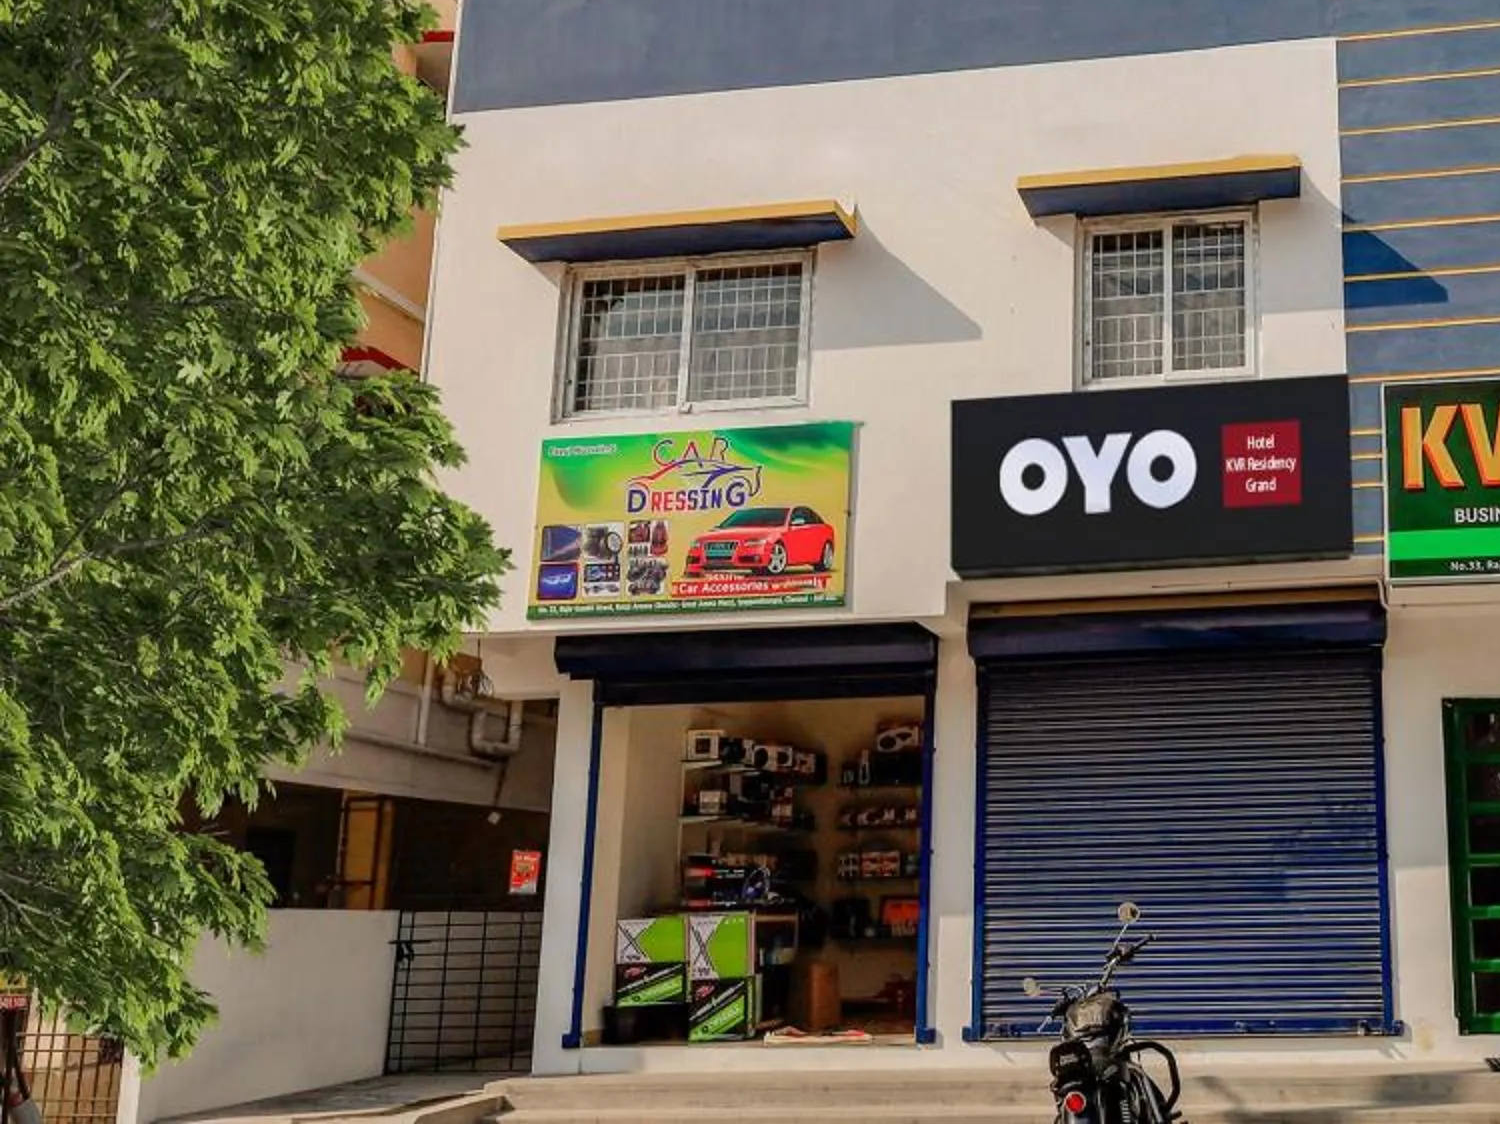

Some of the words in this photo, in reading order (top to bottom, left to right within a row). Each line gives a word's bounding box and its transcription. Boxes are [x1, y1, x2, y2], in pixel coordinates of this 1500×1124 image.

[1247, 434, 1276, 450] Hotel
[653, 436, 729, 469] CAR
[999, 429, 1198, 516] OYO
[1225, 457, 1246, 473] KVR
[1247, 455, 1297, 474] Residency
[1245, 476, 1277, 493] Grand
[627, 480, 747, 514] DRESSING
[679, 583, 699, 595] Car
[701, 580, 769, 594] Accessories
